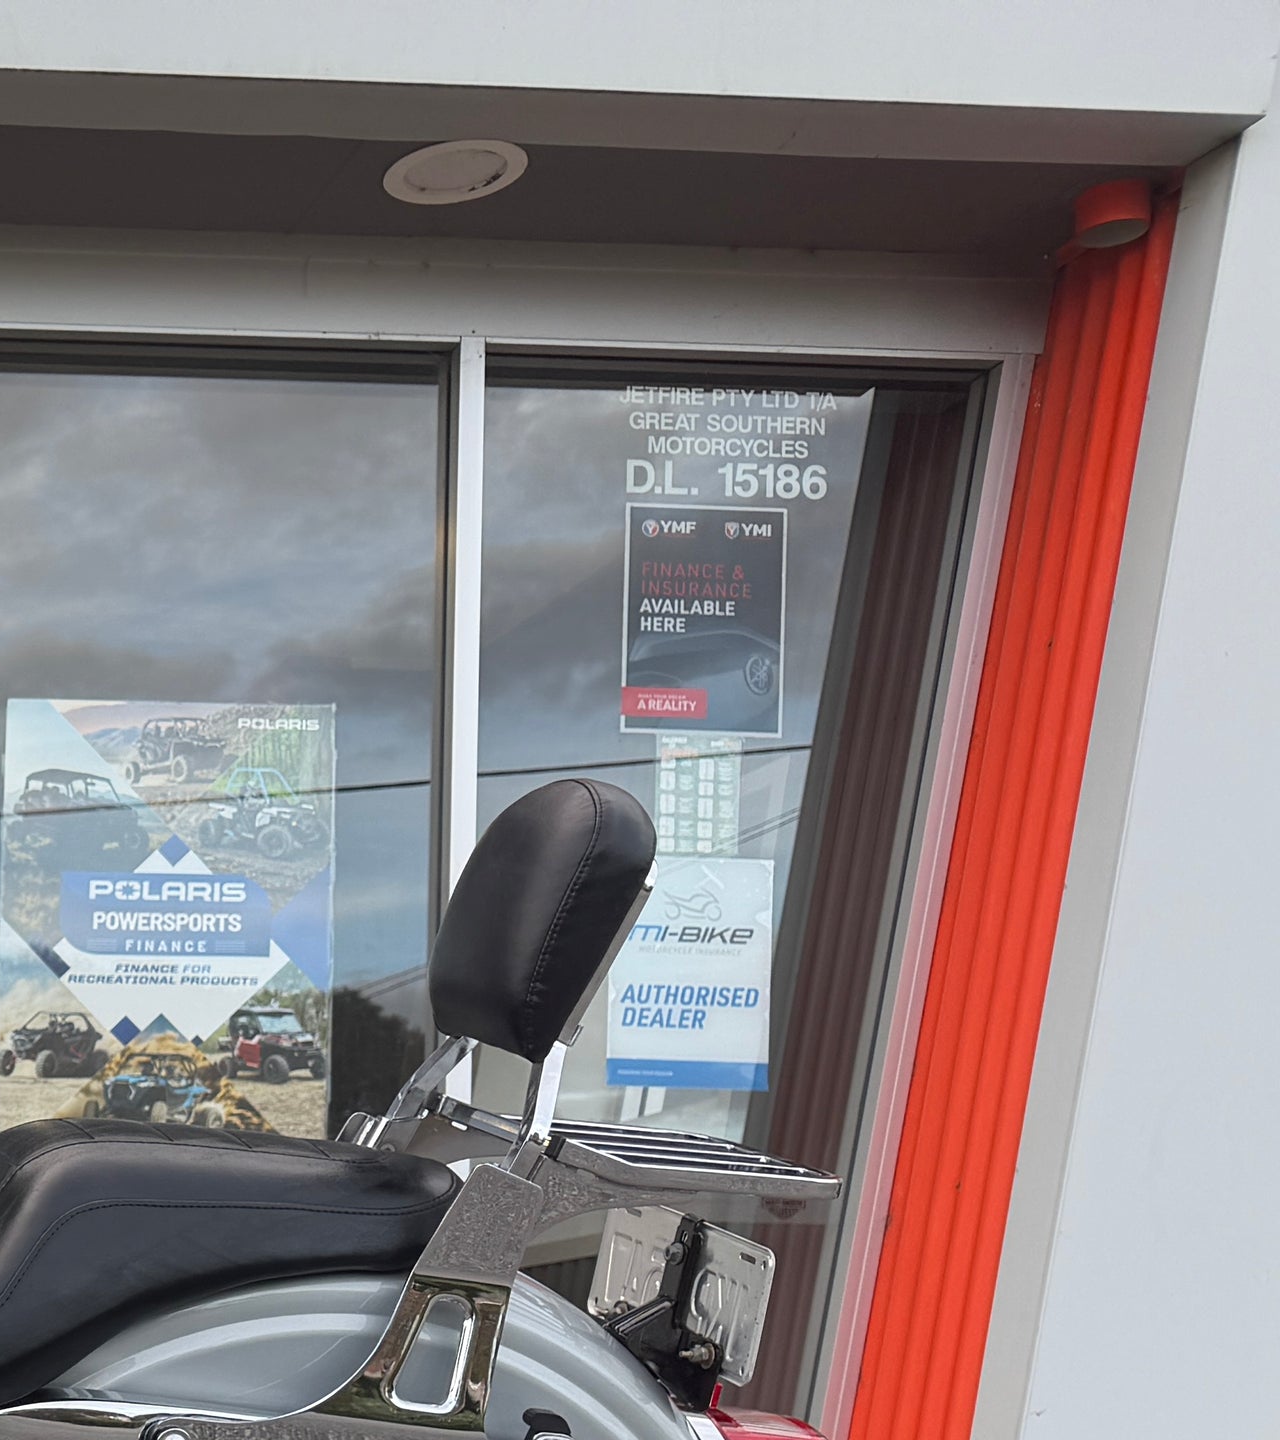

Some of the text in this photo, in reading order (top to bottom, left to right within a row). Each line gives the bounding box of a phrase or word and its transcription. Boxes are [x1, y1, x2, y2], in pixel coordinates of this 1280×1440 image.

[619, 386, 838, 412] JETFIRE PTY LTD T/A
[629, 412, 827, 436] GREAT SOUTHERN
[647, 436, 809, 459] MOTORCYCLES
[625, 459, 829, 501] D.L. 15186
[661, 520, 697, 534] YMF
[741, 523, 773, 537] YMI
[641, 561, 746, 580] FINANCE &
[641, 579, 753, 599] INSURANCE
[640, 597, 736, 616] AVAILABLE
[640, 616, 686, 633] HERE
[637, 698, 697, 712] A REALITY
[237, 717, 320, 731] POLARIS
[89, 879, 247, 903] POLARIS
[92, 911, 243, 933] POWERSPORTS
[124, 938, 207, 953] FINANCE
[114, 963, 212, 974] FINANCE FOR
[67, 974, 259, 987] RECREATIONAL PRODUCTS
[619, 983, 760, 1009] AUTHORISED
[620, 1007, 708, 1030] DEALER
